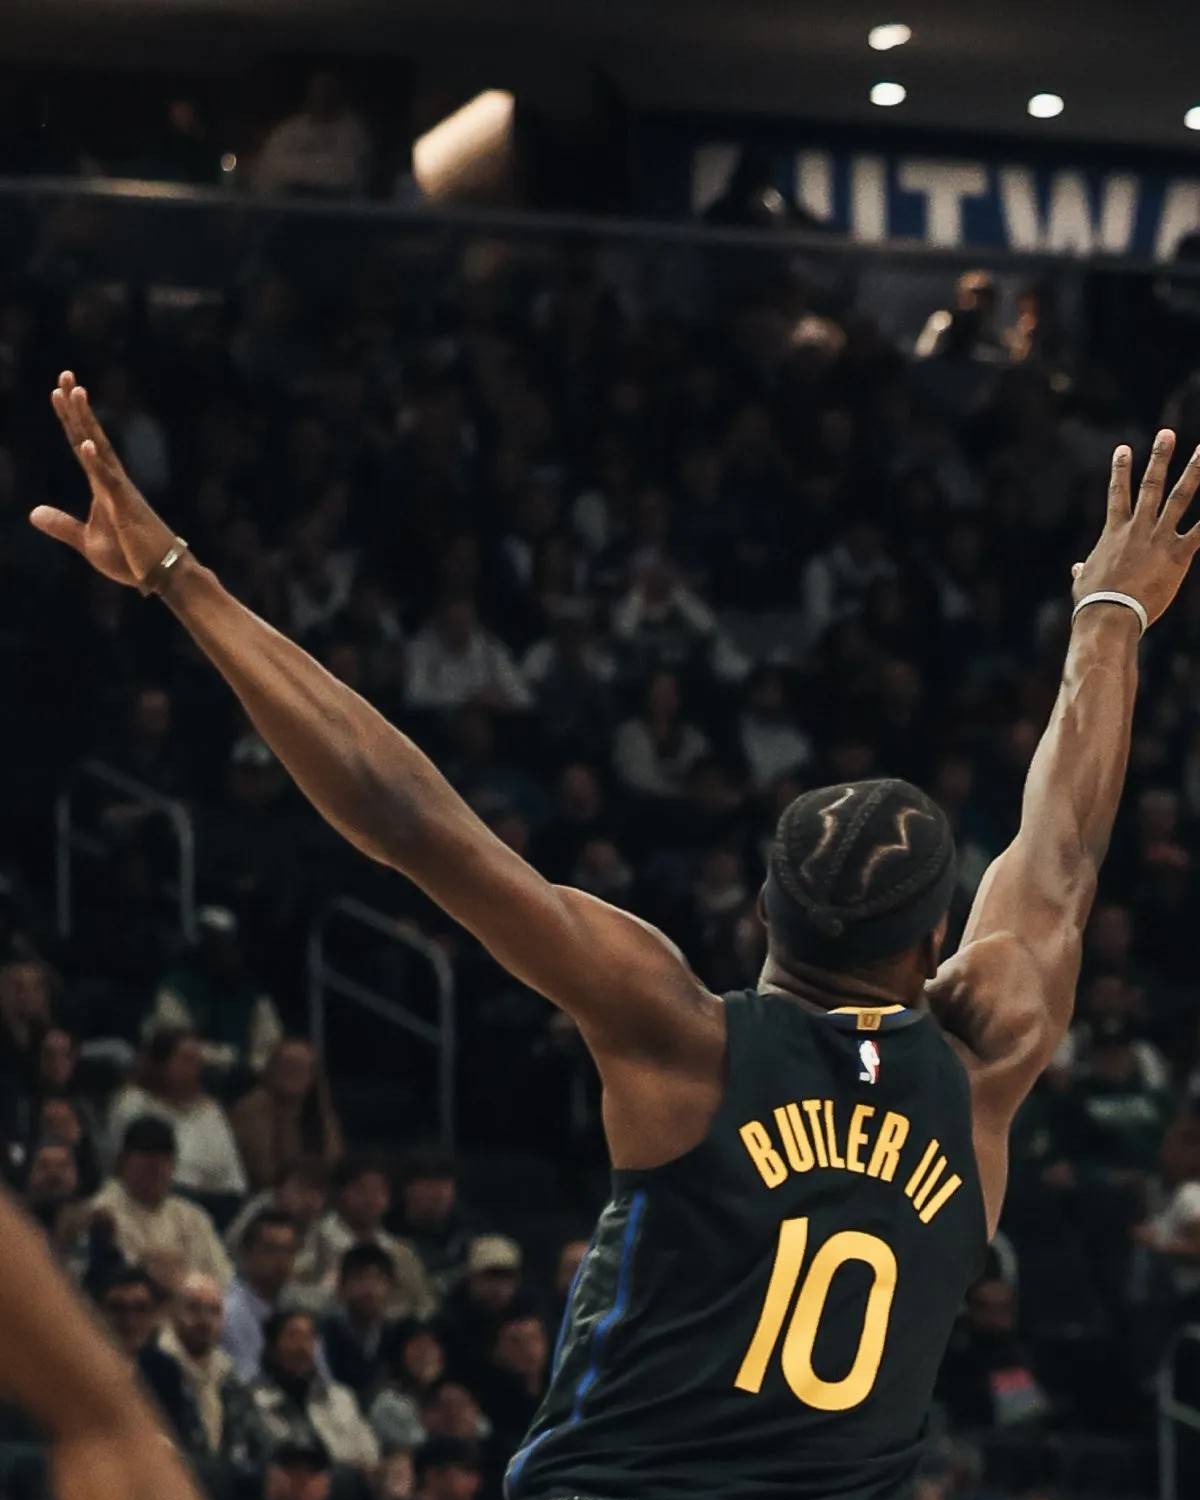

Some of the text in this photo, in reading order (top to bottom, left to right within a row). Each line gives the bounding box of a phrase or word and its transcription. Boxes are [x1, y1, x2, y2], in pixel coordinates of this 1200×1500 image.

[738, 1098, 963, 1225] BUTLER III
[733, 1216, 898, 1411] 10
